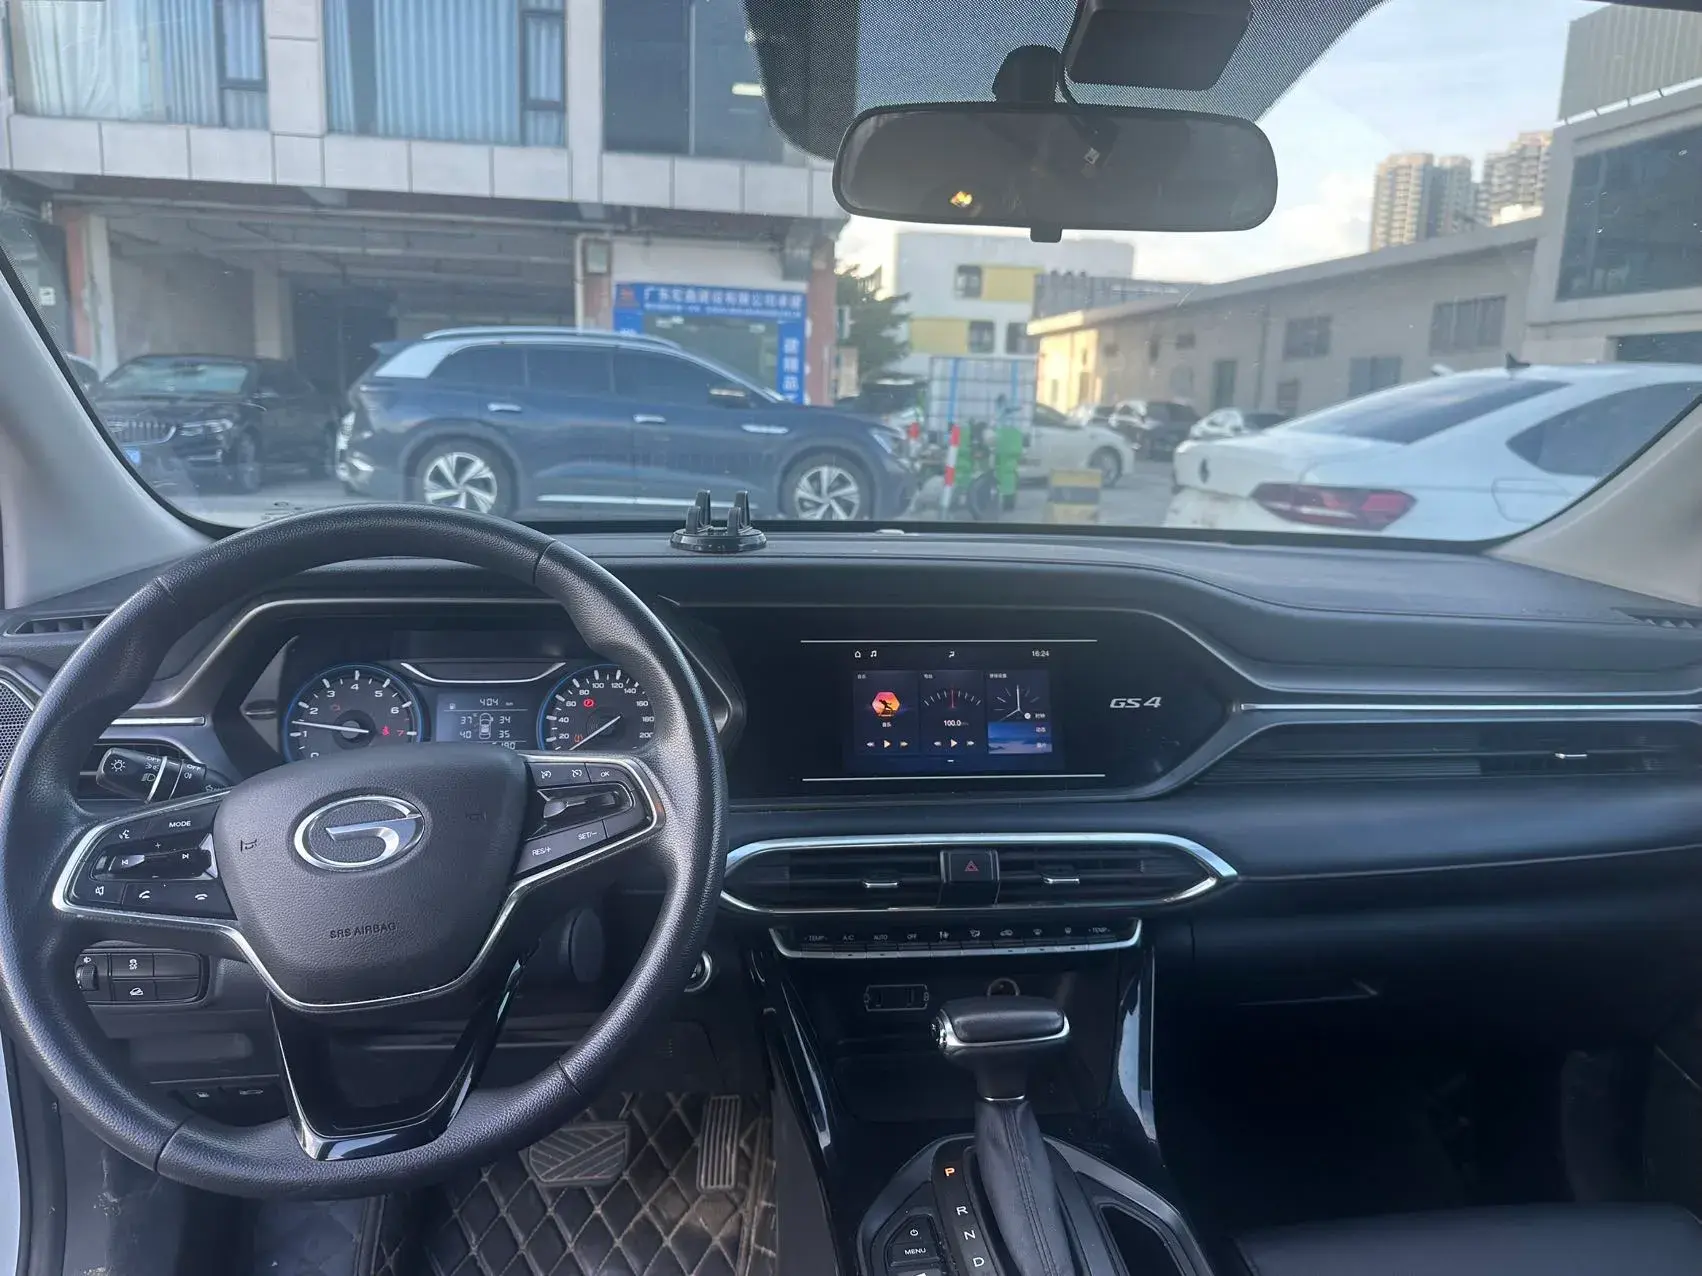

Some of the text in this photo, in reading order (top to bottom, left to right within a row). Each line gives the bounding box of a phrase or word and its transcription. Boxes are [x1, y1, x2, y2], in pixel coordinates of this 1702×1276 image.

[350, 683, 359, 691] 4
[326, 690, 336, 698] 3
[374, 690, 383, 698] 5
[479, 698, 499, 706] 404
[309, 707, 319, 715] 2
[390, 706, 399, 714] 6
[460, 716, 473, 725] 37
[499, 716, 511, 724] 34
[943, 719, 961, 727] 100.0
[303, 730, 308, 738] 1
[396, 729, 405, 737] 7
[459, 730, 472, 739] 40
[498, 730, 510, 738] 35
[186, 763, 201, 771] OFF
[600, 770, 610, 778] OK
[168, 820, 192, 828] MODE
[330, 922, 397, 939] SRS AIRBAG
[944, 1167, 956, 1177] P
[956, 1205, 969, 1216] R
[963, 1229, 976, 1241] N
[904, 1247, 927, 1256] MENU
[972, 1256, 985, 1268] D
